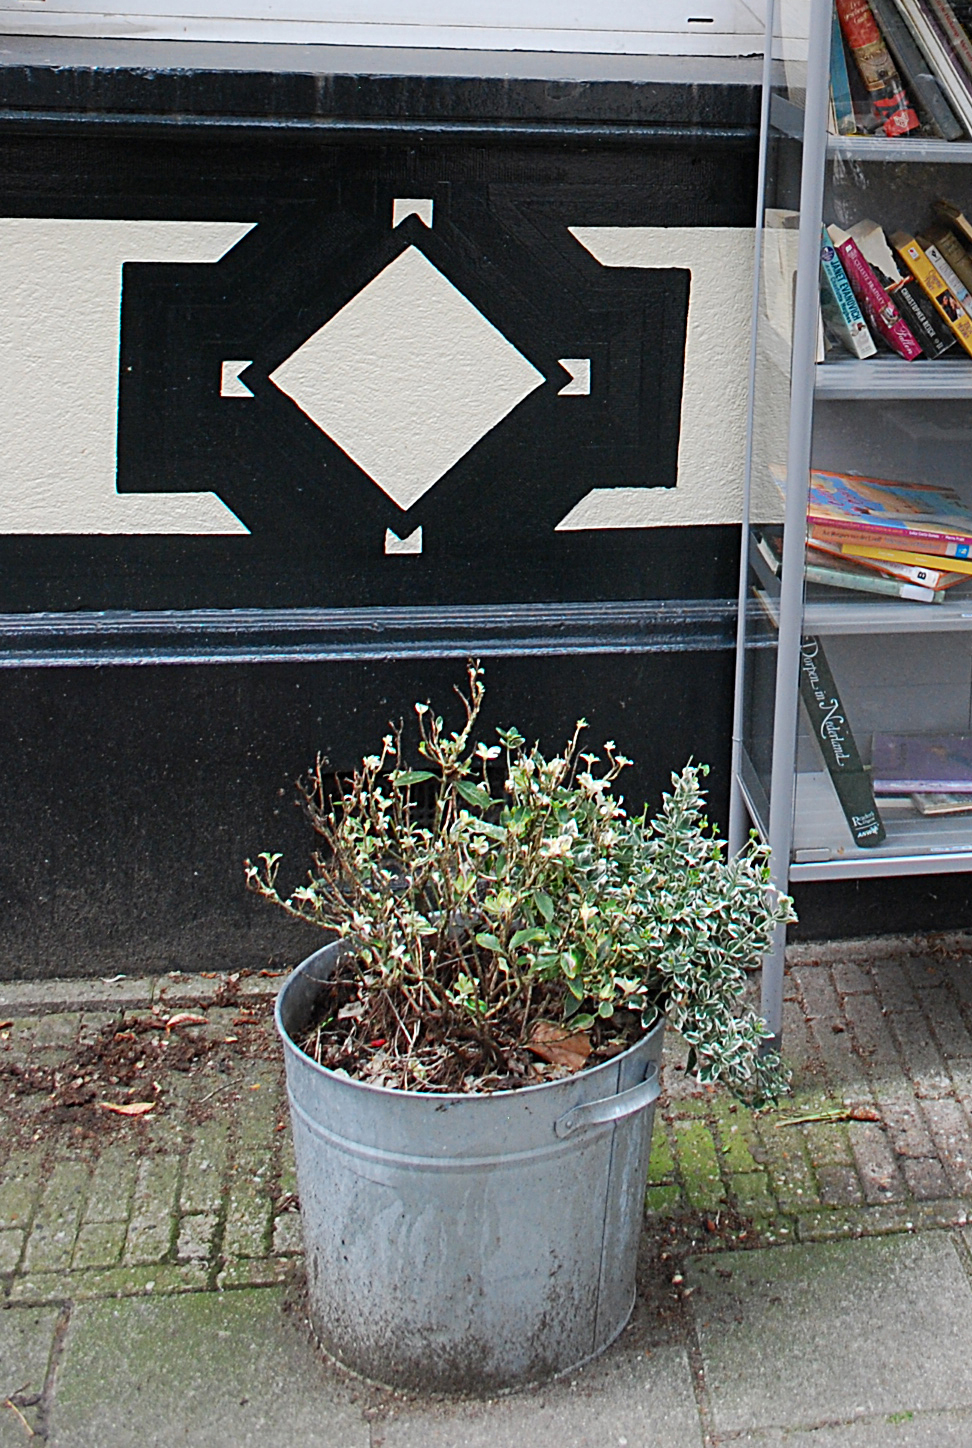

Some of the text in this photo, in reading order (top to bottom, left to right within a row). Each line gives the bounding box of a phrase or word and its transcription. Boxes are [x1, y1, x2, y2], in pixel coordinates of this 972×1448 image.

[830, 260, 861, 321] JANET EVANOVICH
[867, 279, 885, 306] BRADLEY
[840, 302, 851, 323] Hughes
[901, 287, 936, 337] CHRISTOPHER REICH
[894, 324, 915, 355] Fallen
[800, 635, 850, 767] Dorpen in Nederland
